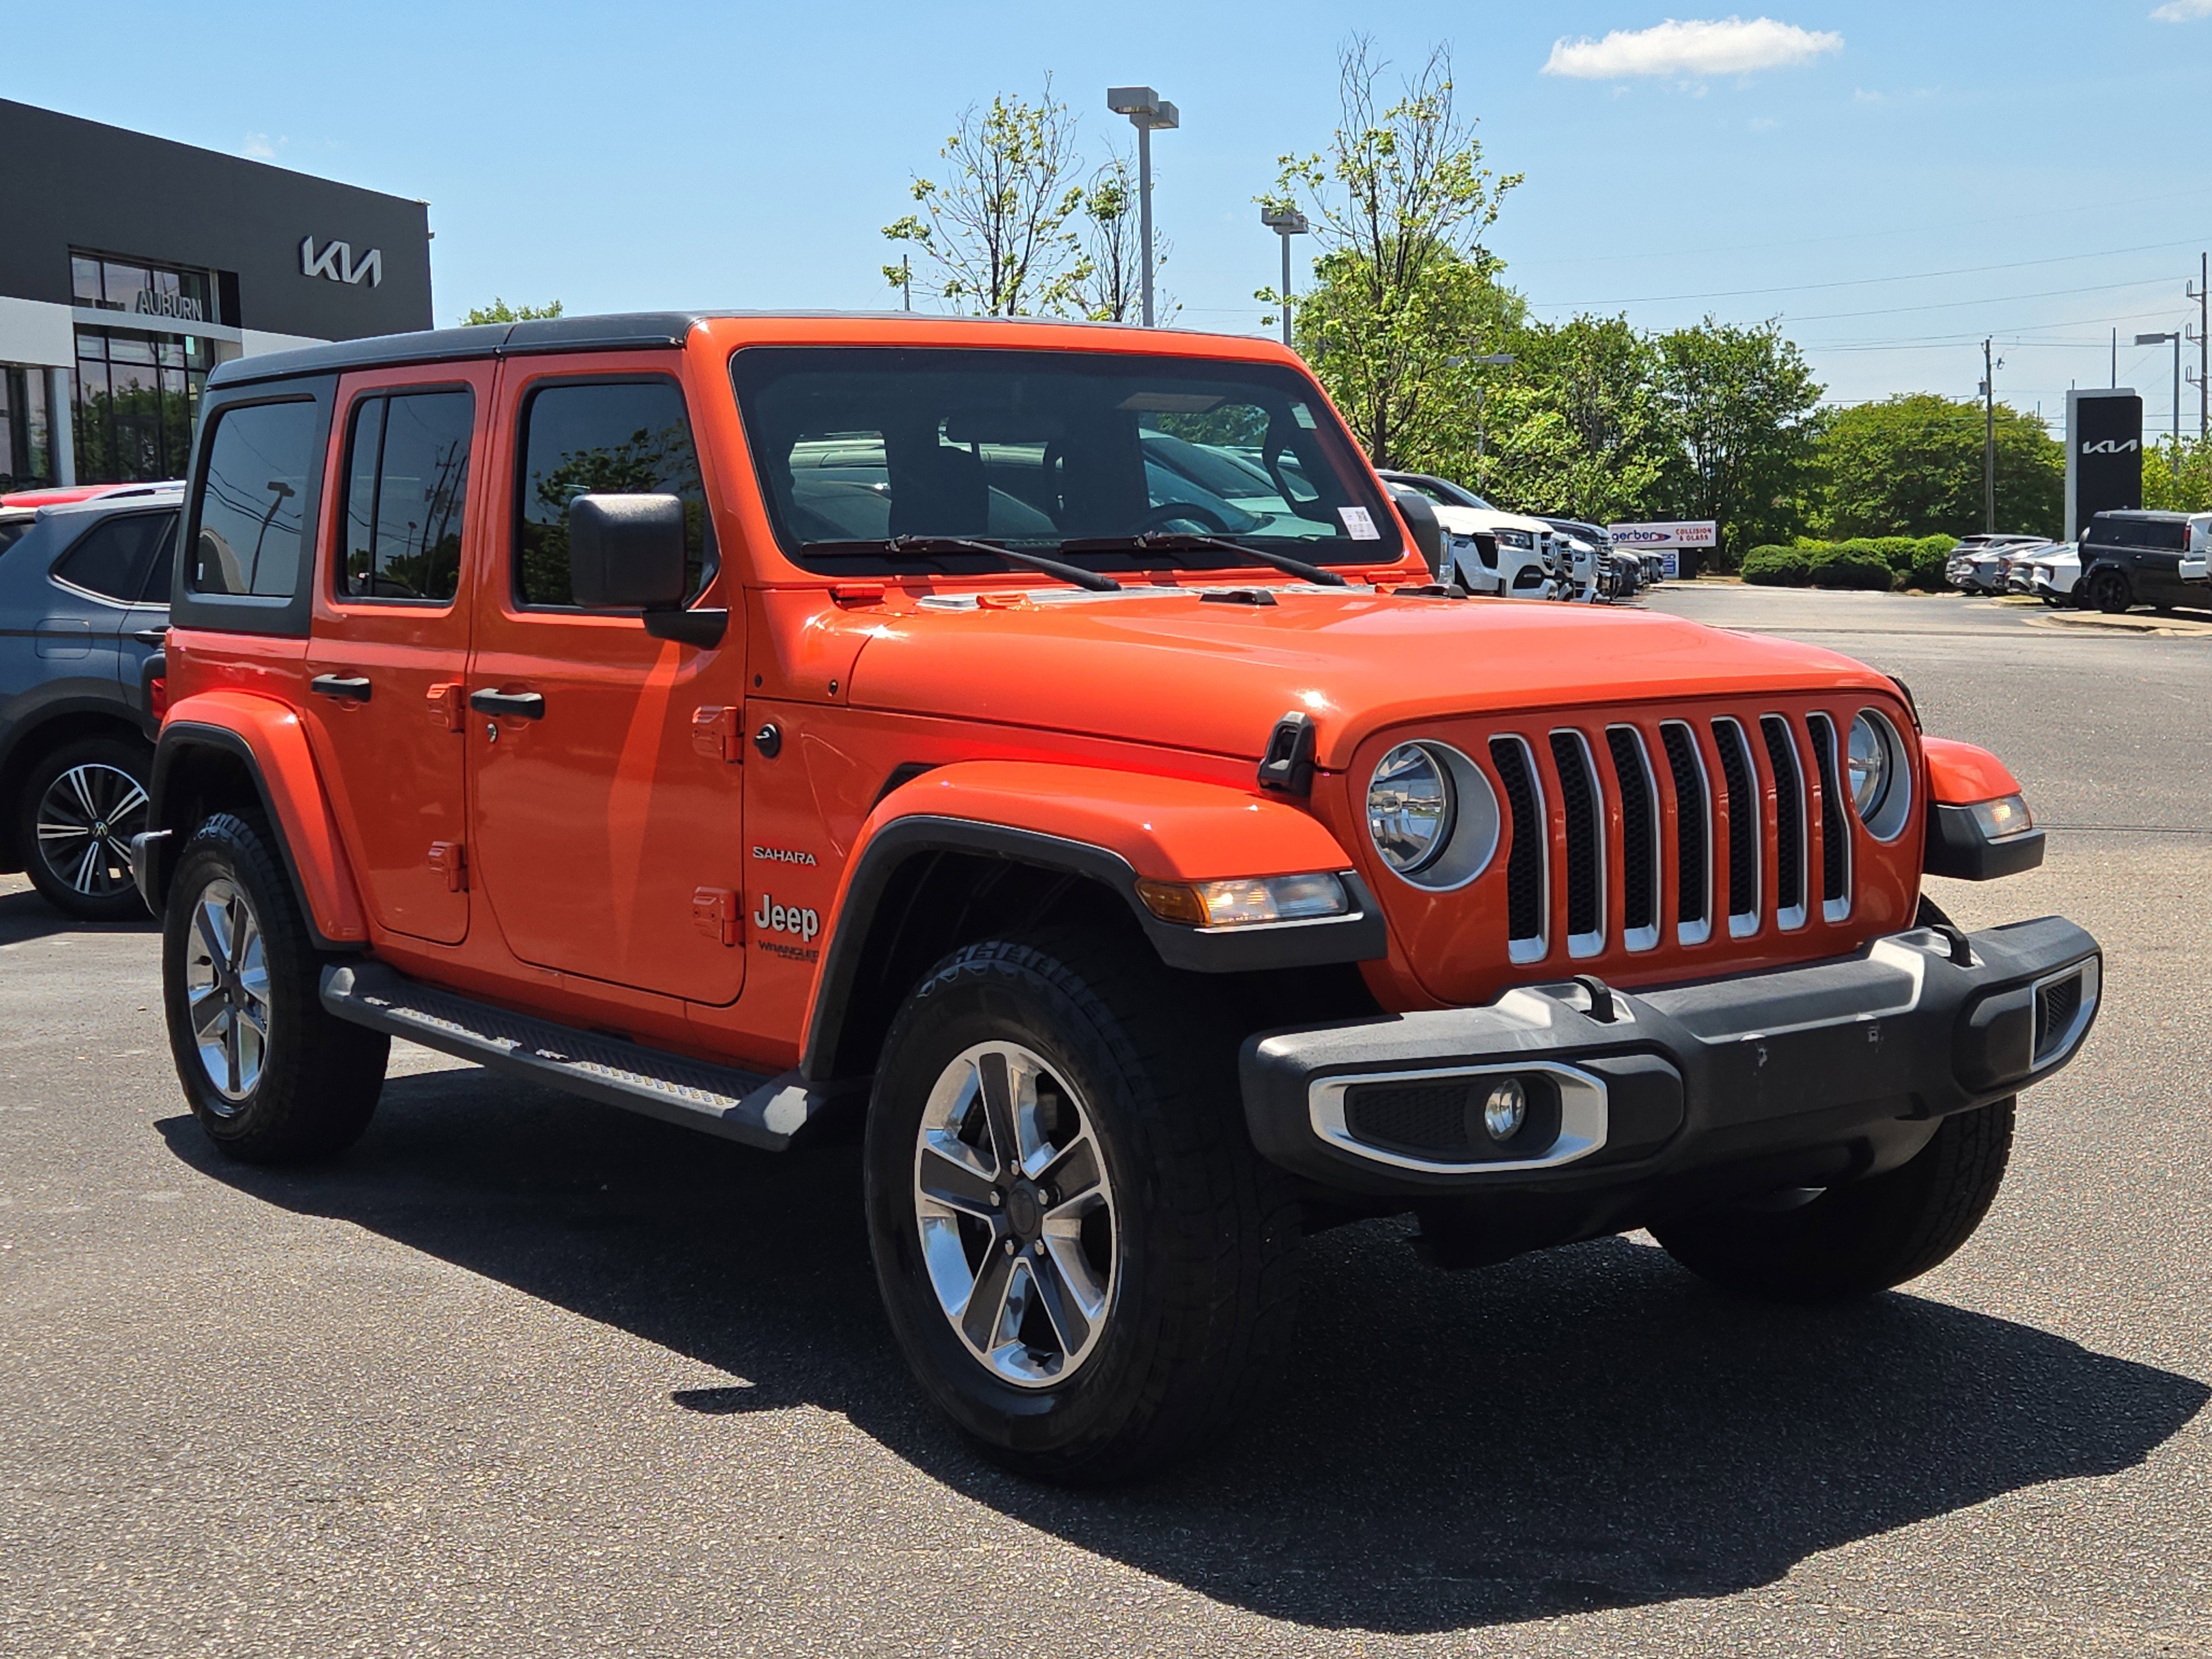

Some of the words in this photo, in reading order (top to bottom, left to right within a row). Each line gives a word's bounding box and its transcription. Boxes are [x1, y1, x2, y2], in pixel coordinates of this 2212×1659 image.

[302, 235, 382, 288] KIA
[138, 290, 203, 321] AUBURN
[2082, 439, 2138, 454] KIA
[1612, 530, 1657, 543] gerber
[753, 846, 817, 866] SAHARA
[754, 893, 818, 942] Jeep
